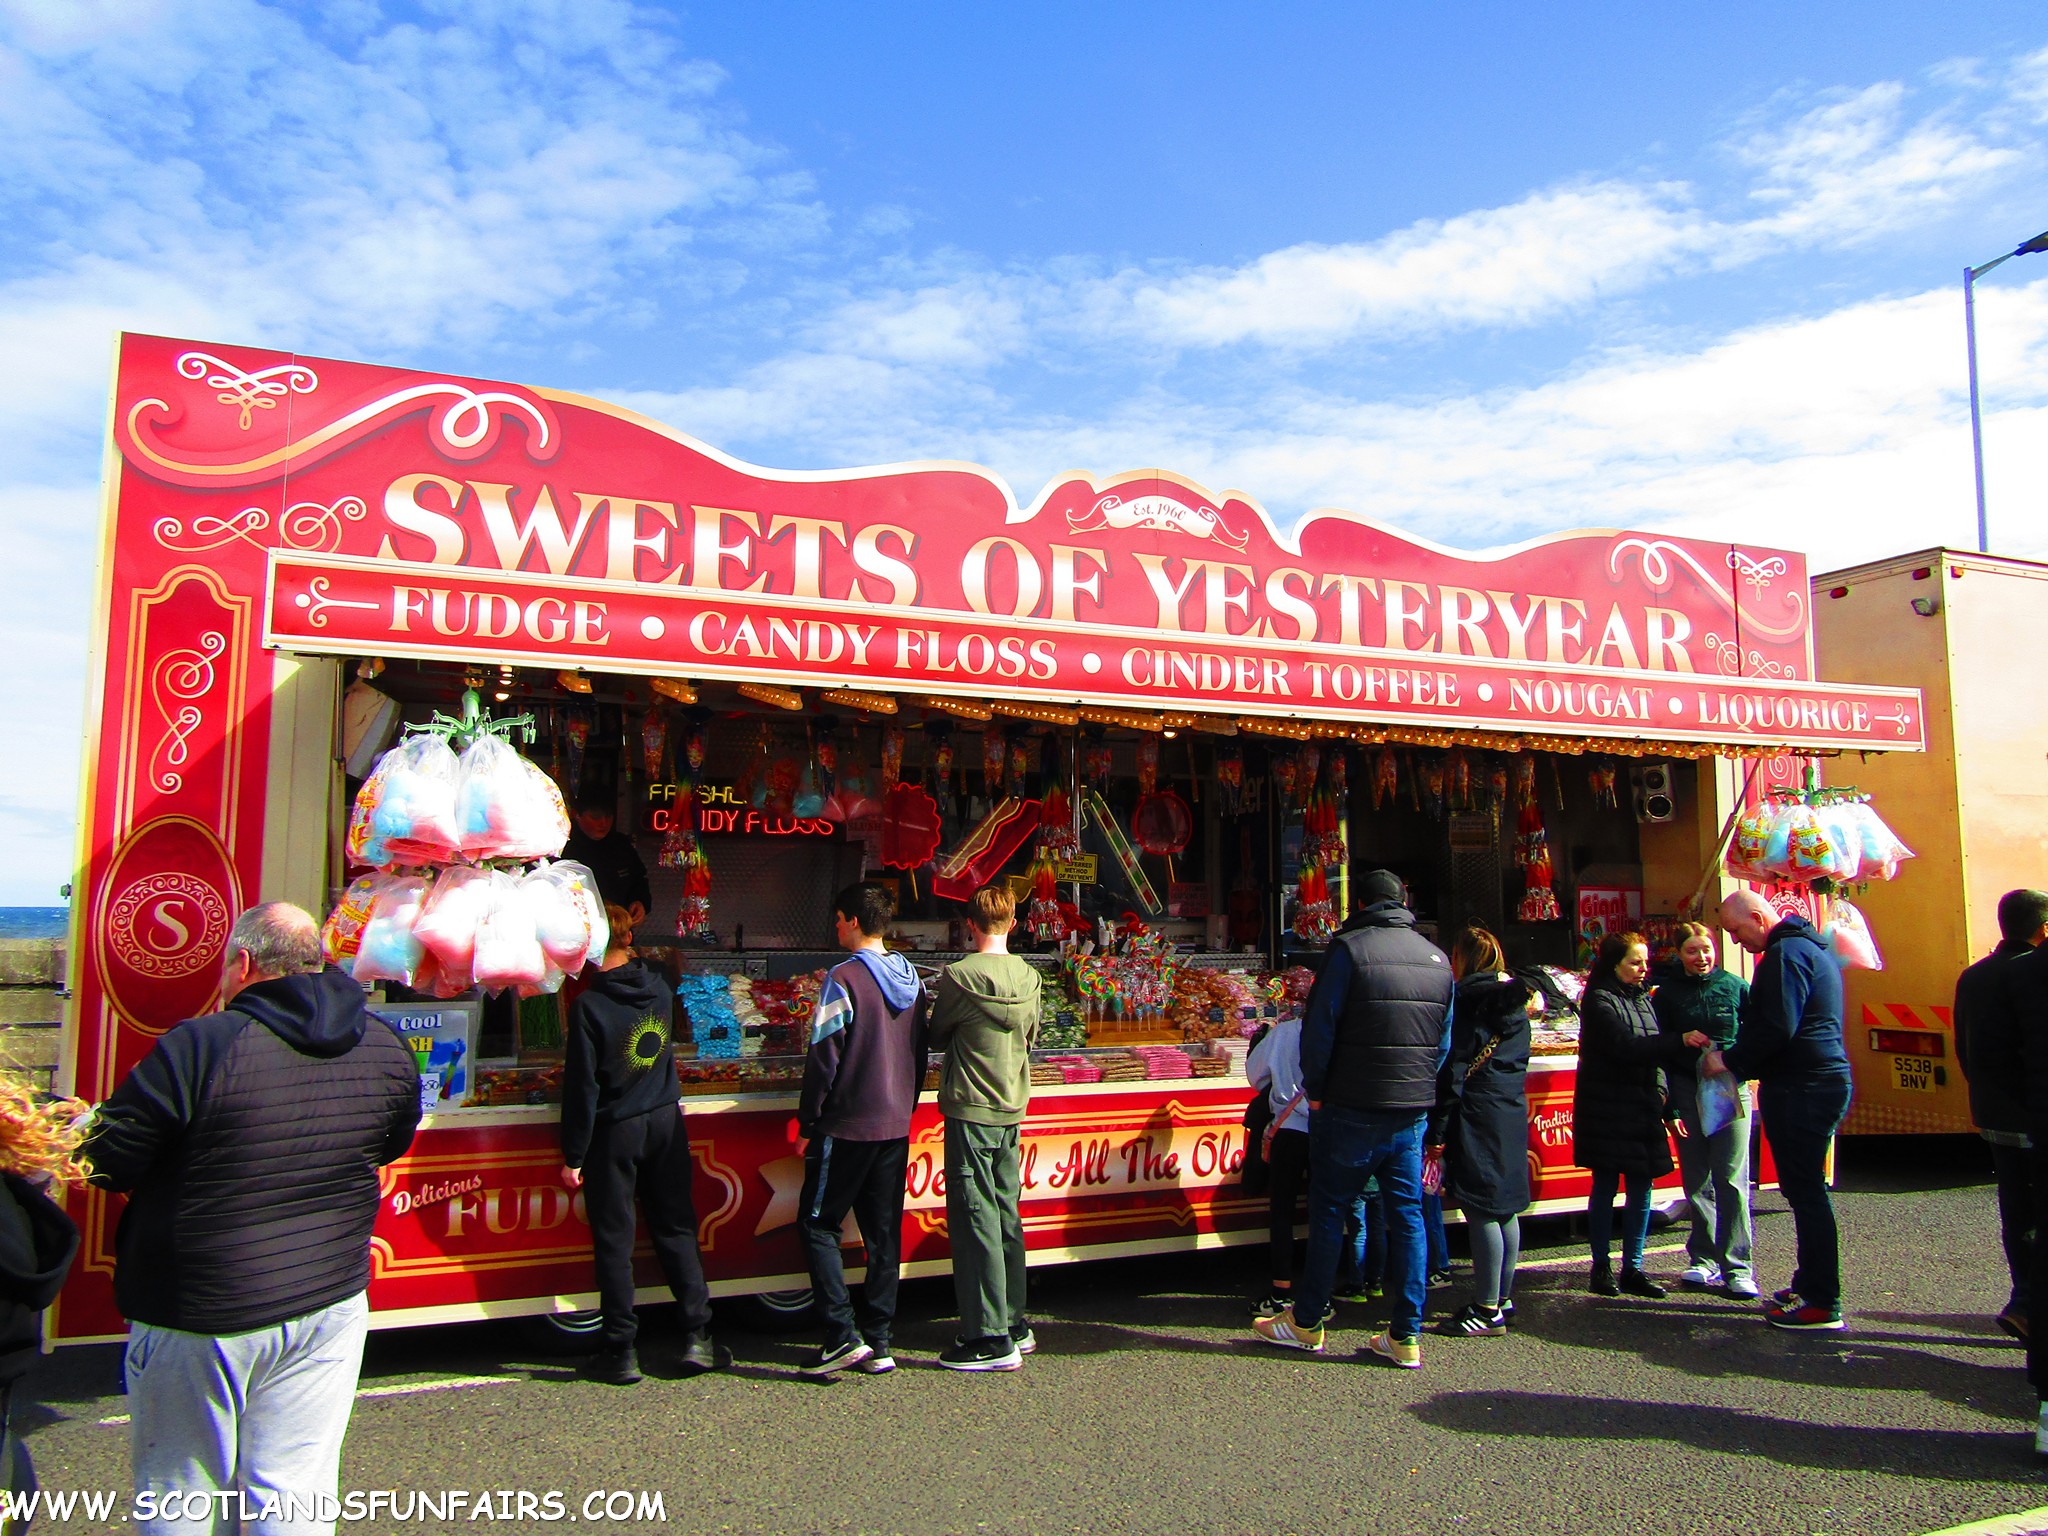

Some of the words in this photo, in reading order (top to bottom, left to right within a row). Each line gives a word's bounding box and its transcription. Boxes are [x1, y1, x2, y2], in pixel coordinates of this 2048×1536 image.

[1133, 503, 1154, 516] Est.
[1157, 503, 1186, 520] 1960
[377, 473, 917, 606] SWEETS
[961, 536, 1110, 622] OF
[1132, 552, 1697, 674] YESTERYEAR
[389, 585, 611, 646] FUDGE
[689, 610, 882, 666] CANDY
[895, 628, 1058, 680] FLOSS
[1121, 647, 1292, 696] CINDER
[1303, 661, 1461, 707] TOFFEE
[1507, 678, 1654, 721] NOUGAT
[1698, 691, 1872, 733] LIQUORICE
[650, 784, 748, 804] FRSHL
[653, 810, 738, 832] CDY
[1894, 1057, 1932, 1074] S538
[1900, 1073, 1928, 1090] BNV
[1534, 1109, 1573, 1132] Traditi
[906, 1151, 946, 1199] We
[1048, 1138, 1111, 1188] All
[1121, 1135, 1181, 1183] The
[392, 1174, 482, 1216] Delicious
[444, 1185, 590, 1237] FUD
